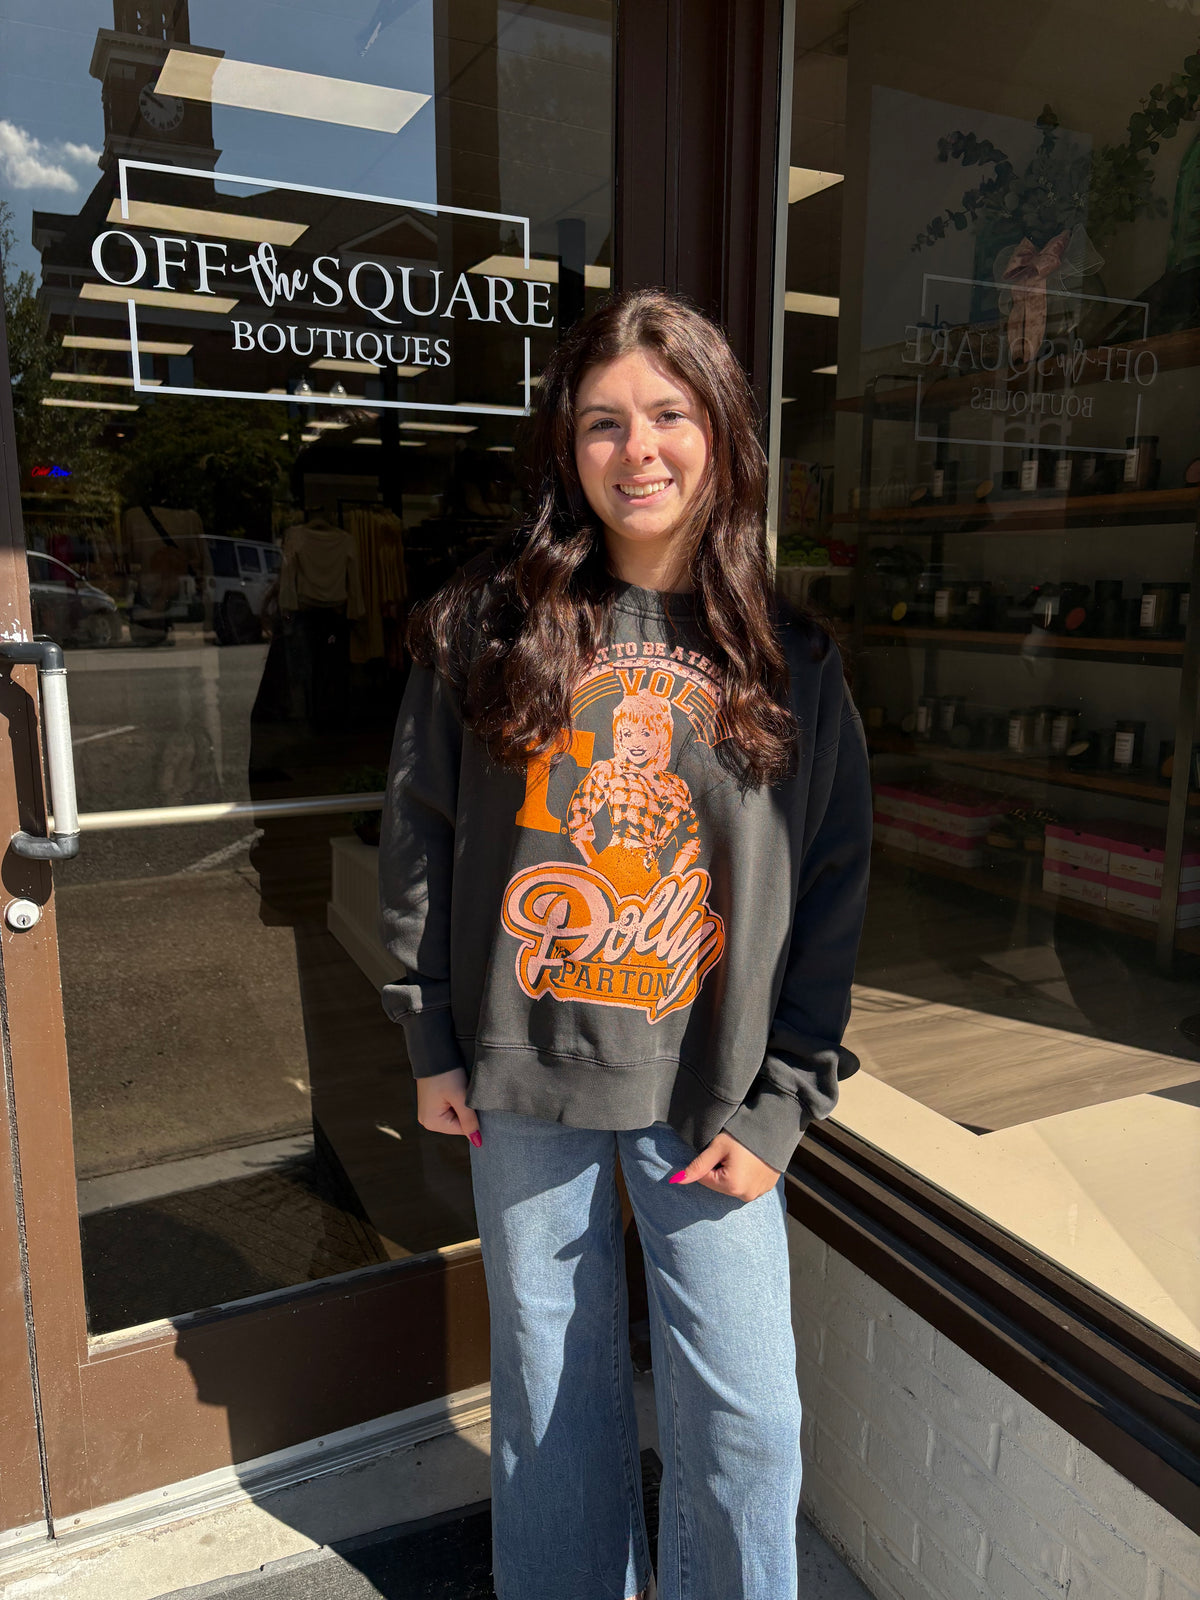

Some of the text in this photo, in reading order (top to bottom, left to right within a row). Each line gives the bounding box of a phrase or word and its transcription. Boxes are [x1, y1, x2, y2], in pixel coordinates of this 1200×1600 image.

[91, 230, 555, 329] OFF the SQUARE
[231, 320, 451, 368] BOUTIQUES
[611, 641, 638, 658] TO
[642, 641, 667, 657] BE
[669, 646, 685, 662] A
[616, 667, 700, 714] VOL
[505, 871, 716, 1011] Dolly
[558, 959, 675, 998] PARTON
